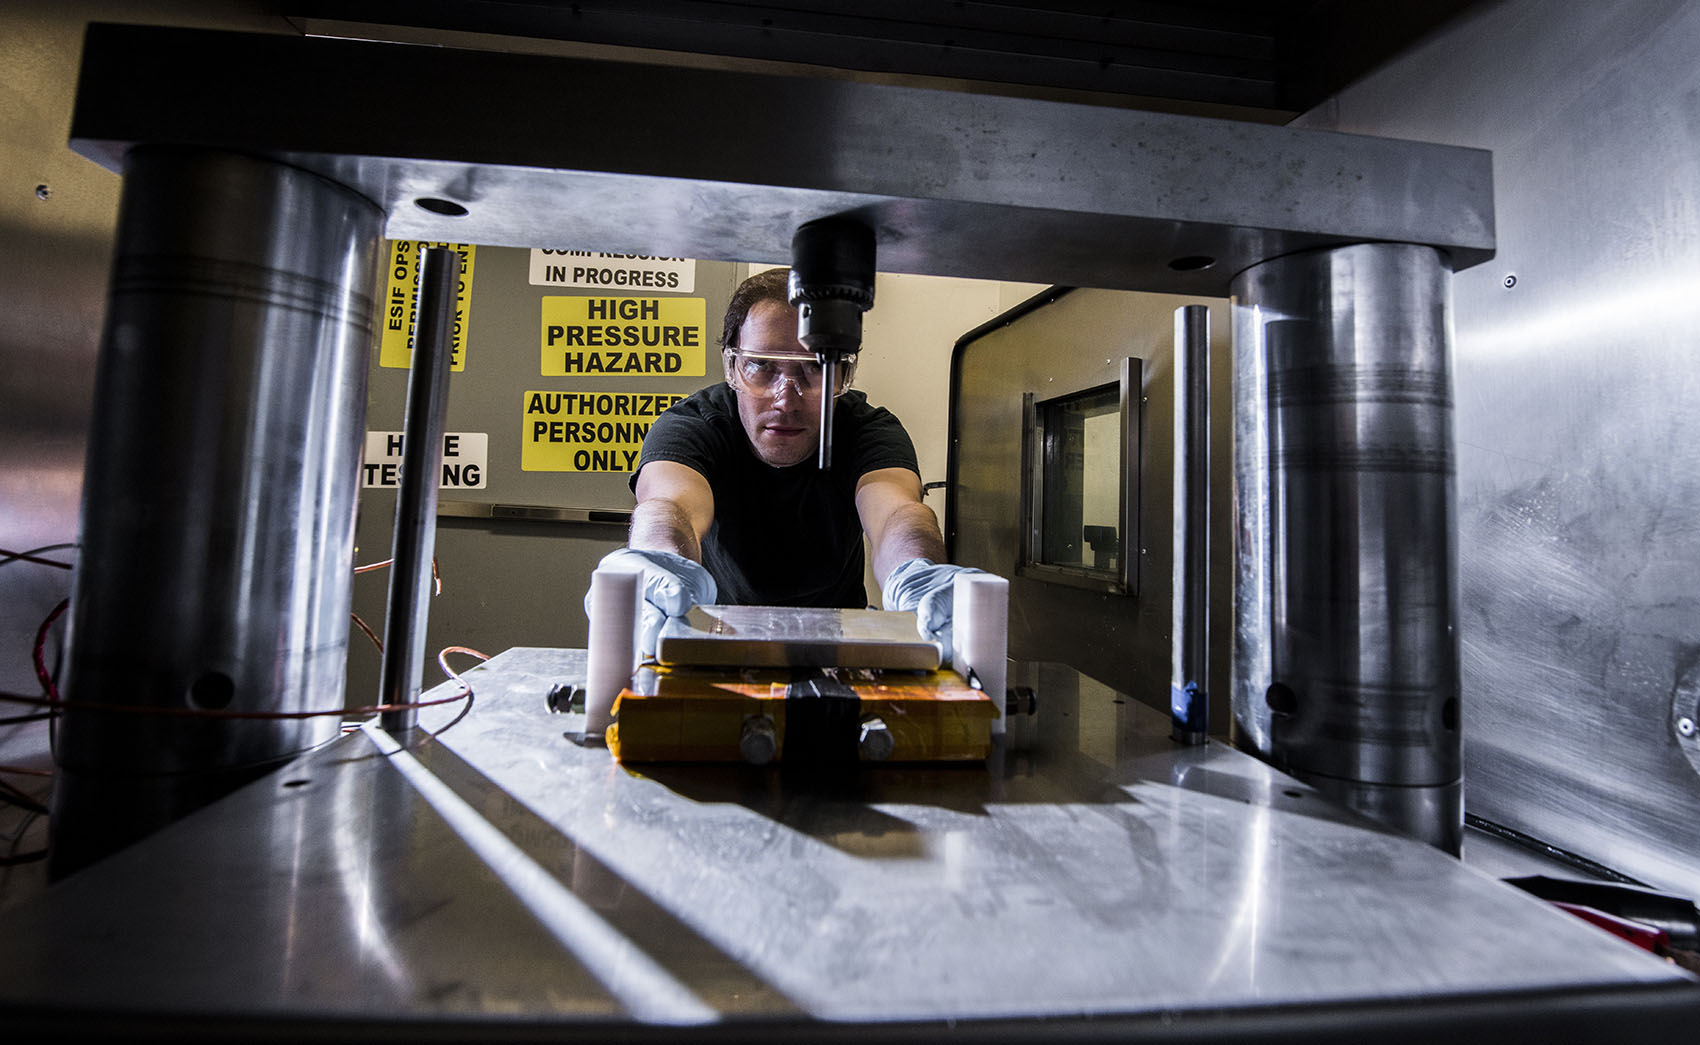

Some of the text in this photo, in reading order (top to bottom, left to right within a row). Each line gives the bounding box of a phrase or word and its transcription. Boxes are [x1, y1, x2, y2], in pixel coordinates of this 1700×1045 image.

[389, 241, 410, 331] ESIF OPS
[545, 266, 679, 288] IN PROGRESS
[588, 299, 659, 320] HIGH
[547, 325, 699, 347] PRESSURE
[565, 352, 682, 373] HAZARD
[533, 421, 653, 444] PERSONN
[387, 435, 459, 457] HE
[574, 450, 638, 471] ONLY
[364, 464, 480, 487] TENG
